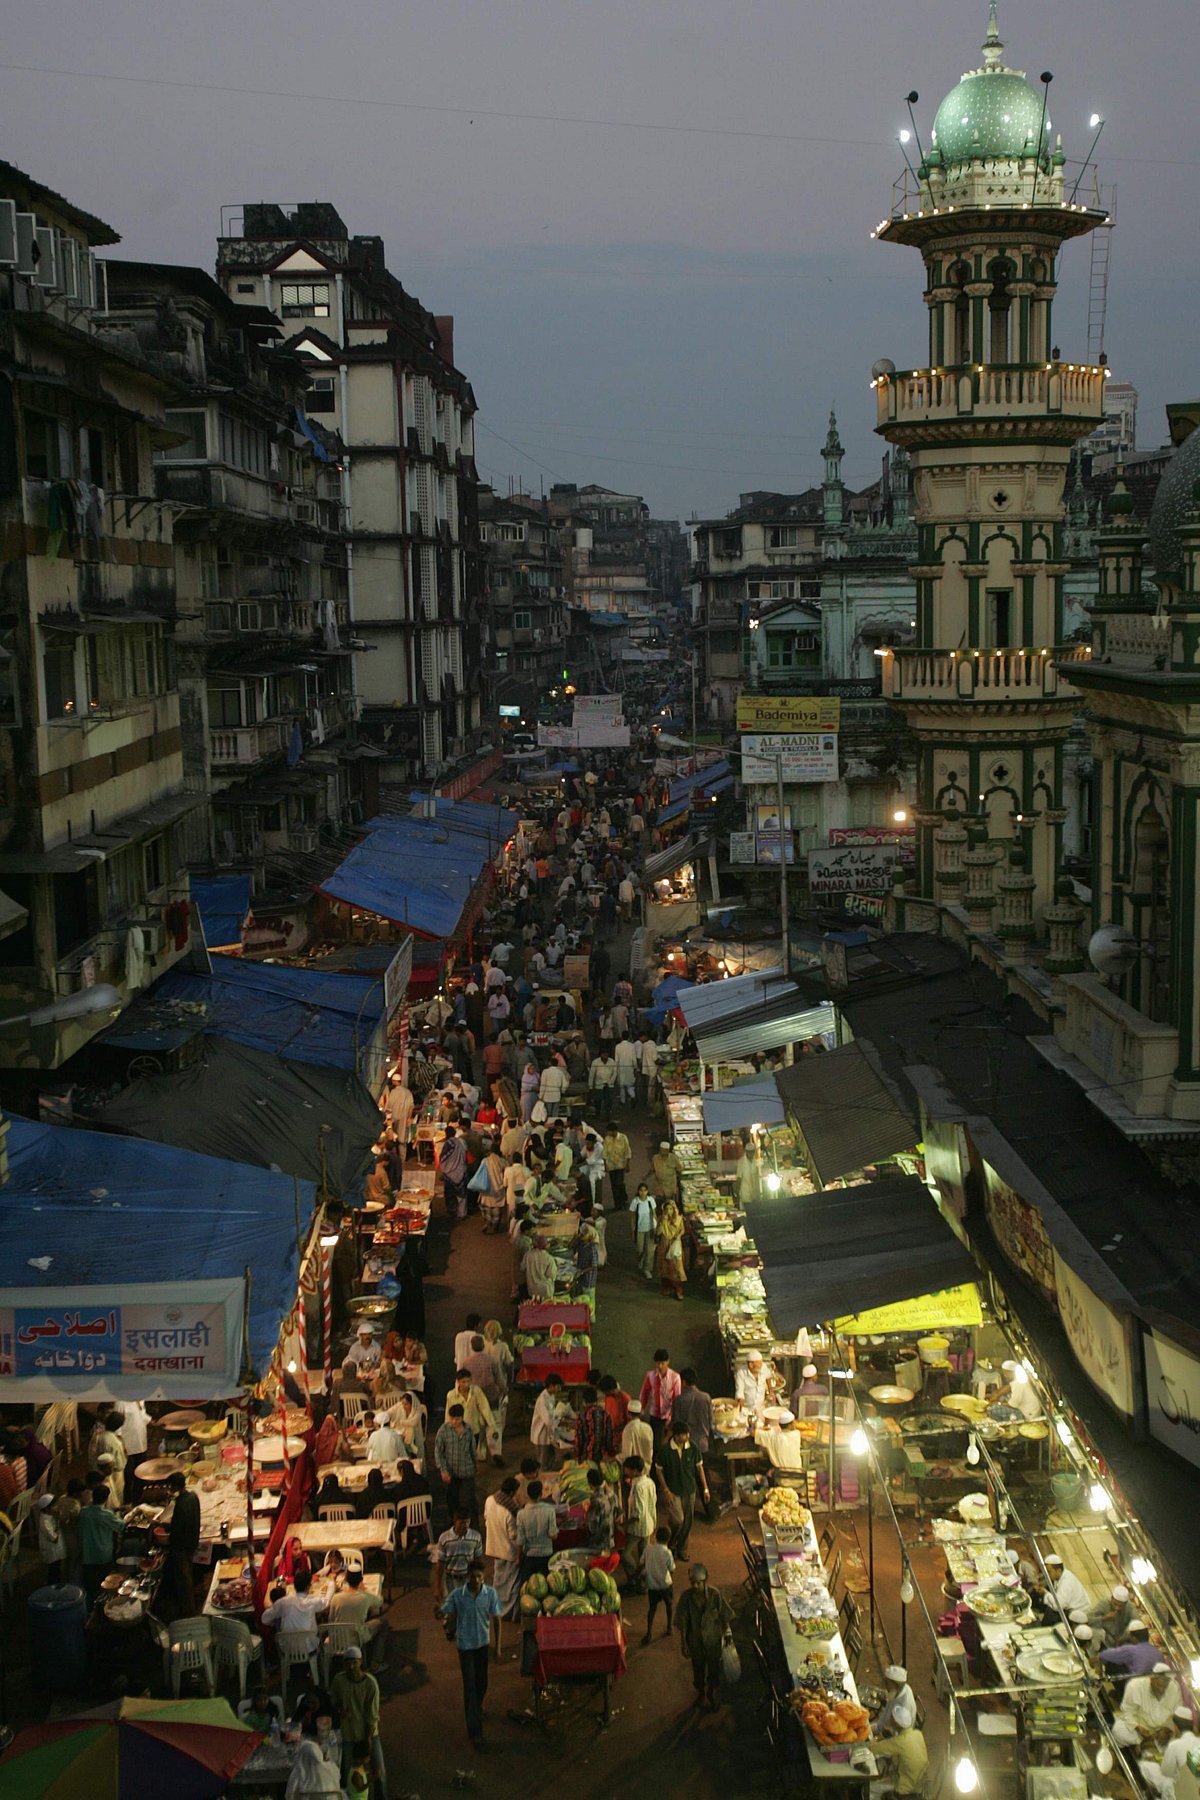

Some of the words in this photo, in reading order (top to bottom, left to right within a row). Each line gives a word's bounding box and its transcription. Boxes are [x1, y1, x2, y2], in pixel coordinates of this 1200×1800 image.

[756, 709, 818, 722] Bademiya
[760, 736, 819, 746] AL-MADNI
[811, 880, 852, 892] MINARA
[124, 1321, 210, 1353] इसलाही
[132, 1356, 204, 1371] दवाखाना
